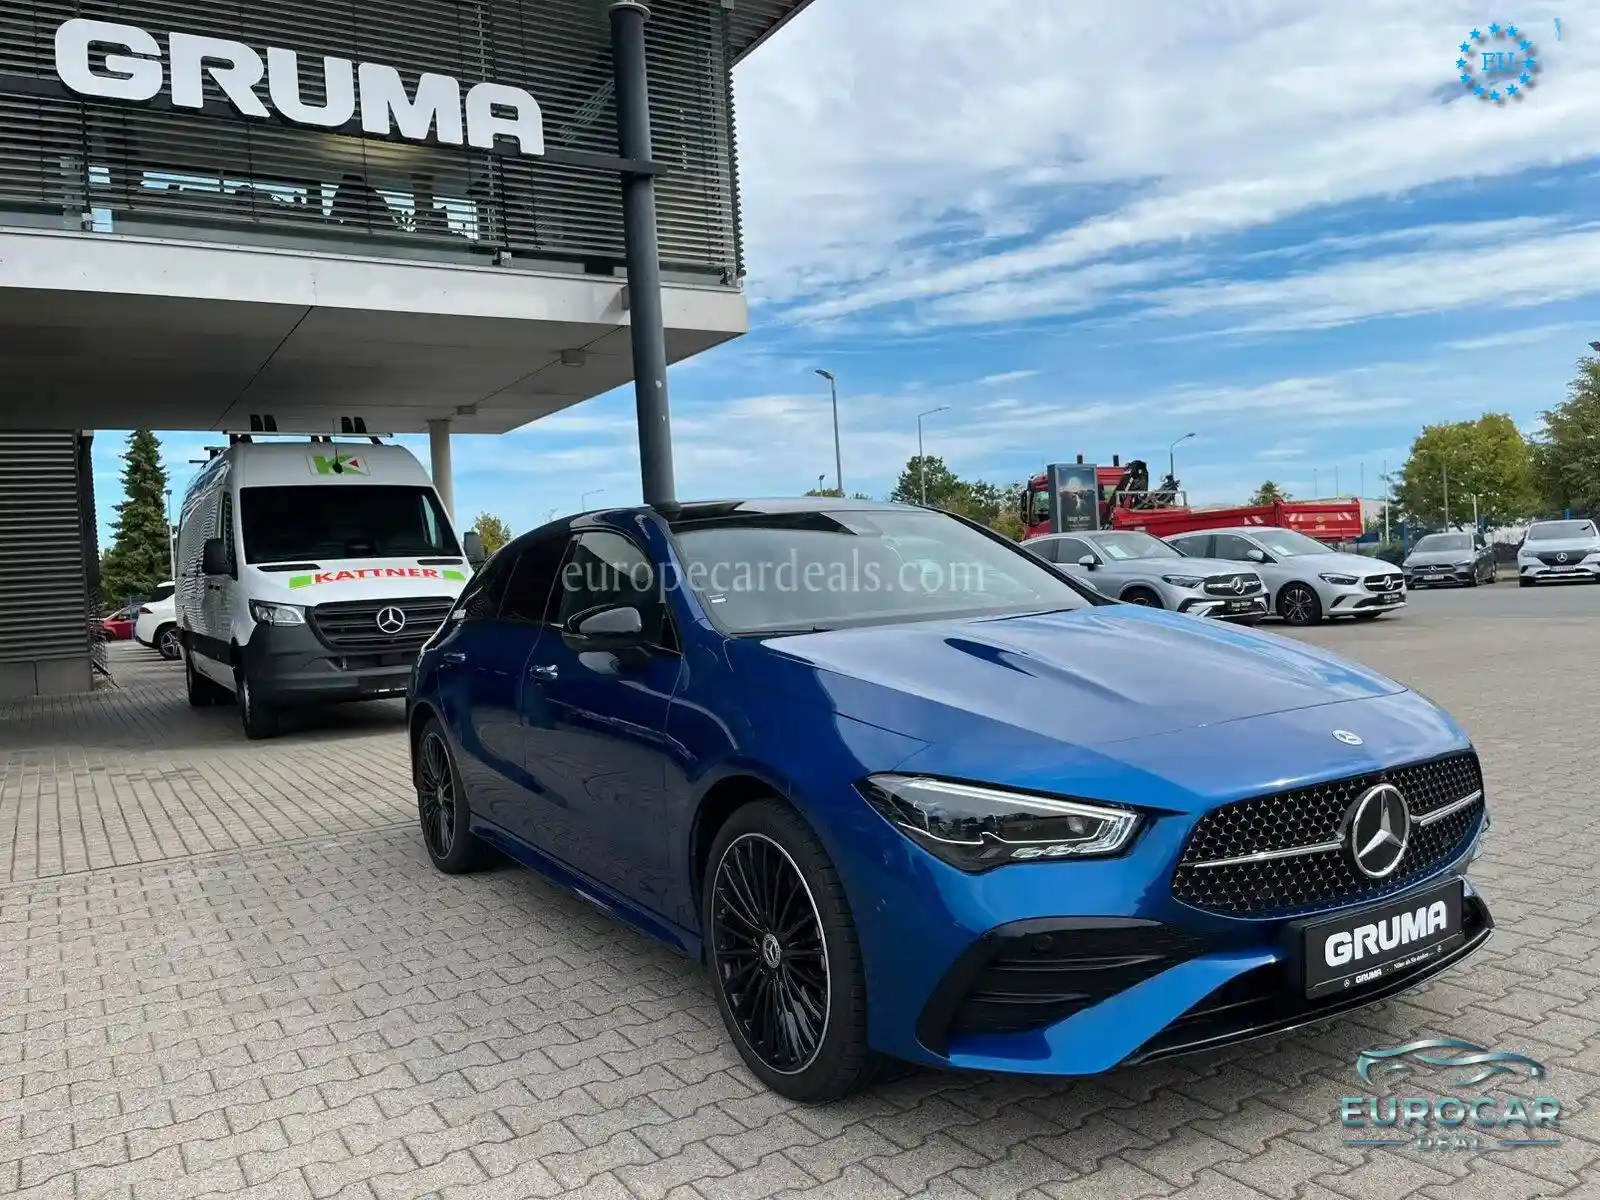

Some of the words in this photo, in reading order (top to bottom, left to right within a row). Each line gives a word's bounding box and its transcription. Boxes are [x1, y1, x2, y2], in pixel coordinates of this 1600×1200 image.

[54, 18, 545, 157] GRUMA
[314, 568, 439, 585] KATTNER
[1324, 900, 1447, 968] GRUMA
[1355, 968, 1382, 984] GRUMA
